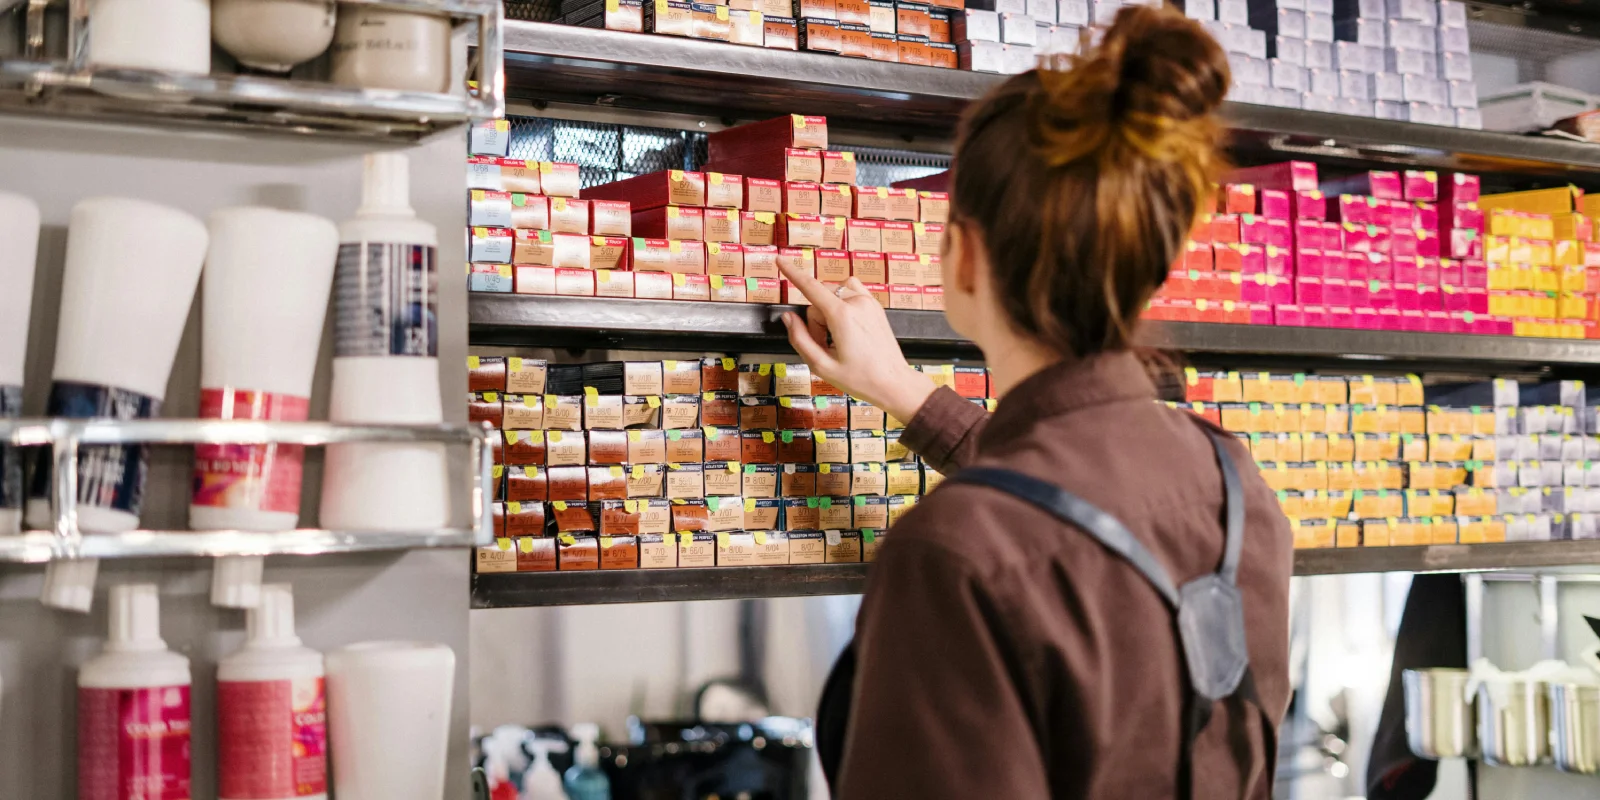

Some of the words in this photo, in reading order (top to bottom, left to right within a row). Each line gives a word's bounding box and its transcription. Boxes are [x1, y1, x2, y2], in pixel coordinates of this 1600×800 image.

[514, 168, 525, 177] 2/0
[519, 371, 535, 380] 55/0
[752, 476, 766, 485] 8/03
[654, 547, 666, 556] 7/0
[728, 545, 744, 555] 8/00
[489, 551, 506, 561] 4/07
